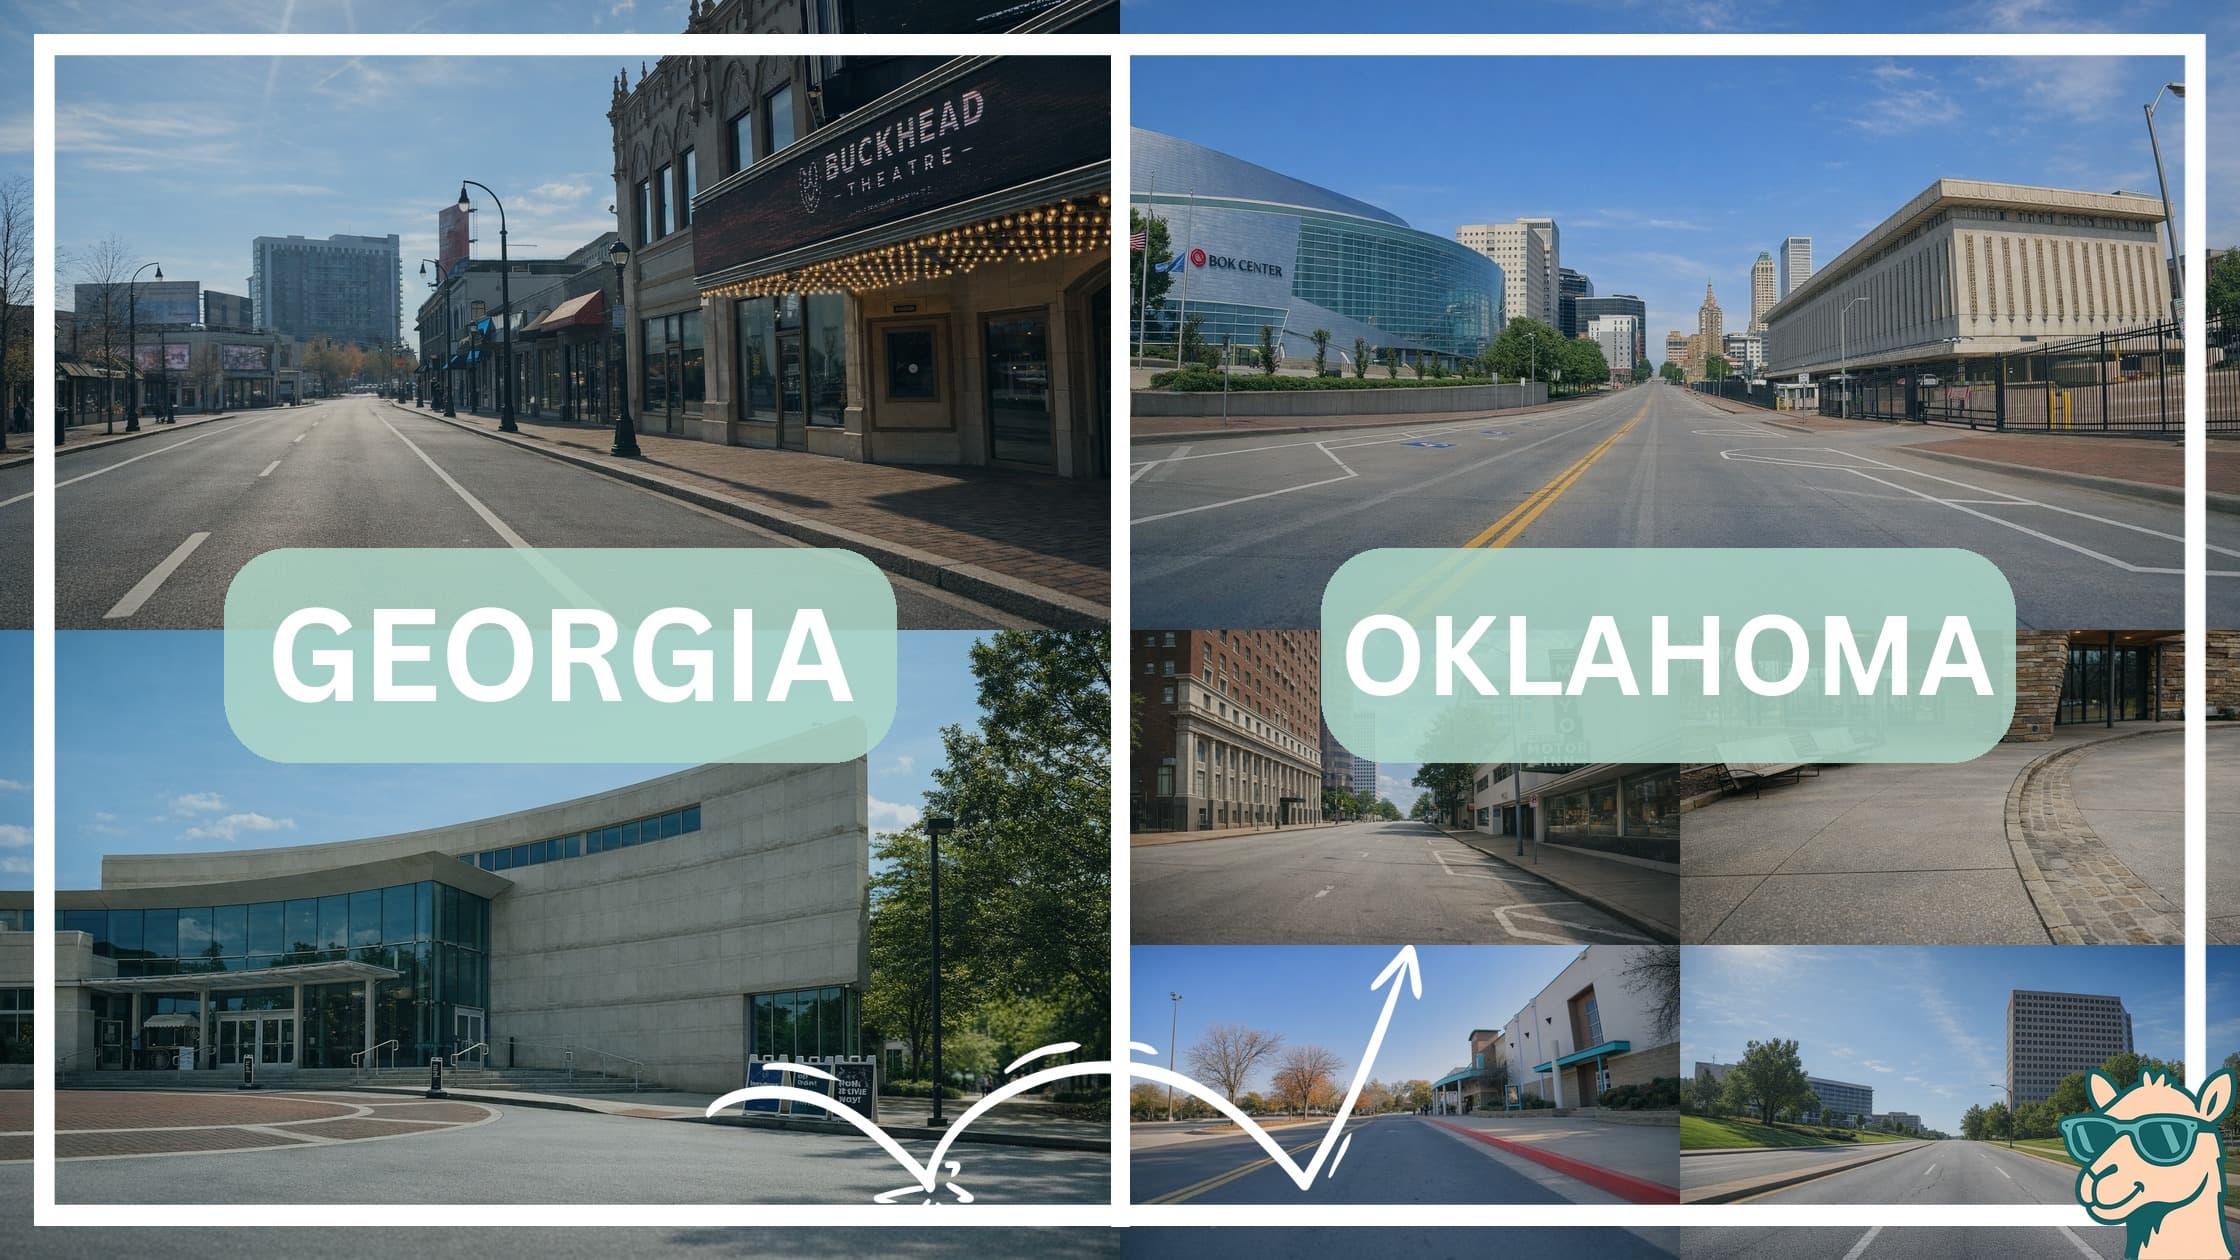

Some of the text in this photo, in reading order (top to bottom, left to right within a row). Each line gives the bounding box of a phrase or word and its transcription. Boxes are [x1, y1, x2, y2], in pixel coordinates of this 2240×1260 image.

[825, 90, 984, 181] BUCKHEAD
[848, 147, 952, 195] THEATRE
[1209, 254, 1282, 277] BOK CENTER
